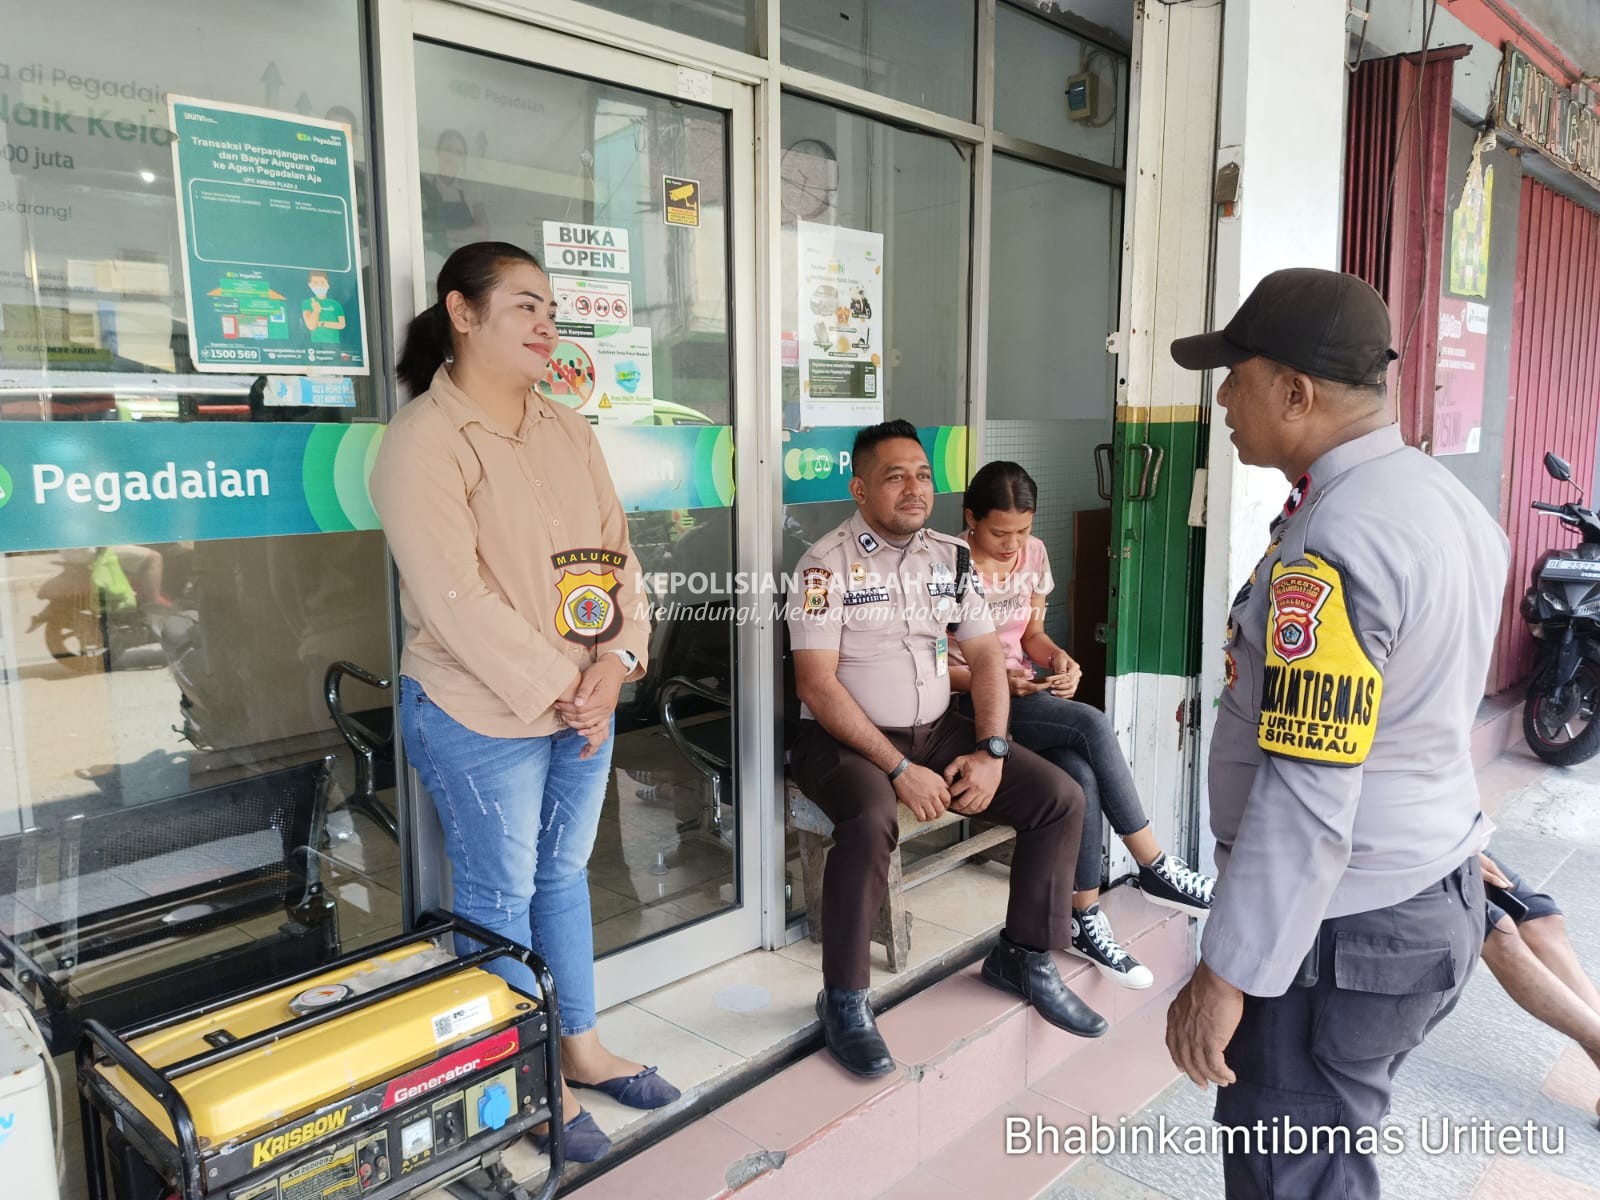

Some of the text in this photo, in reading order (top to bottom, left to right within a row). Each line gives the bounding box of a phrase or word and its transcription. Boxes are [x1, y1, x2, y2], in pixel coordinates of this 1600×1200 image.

[33, 147, 74, 169] juta
[191, 136, 337, 166] Transaksi Perpanjangan Gadai
[219, 152, 316, 173] dan Bayar Angsuran
[213, 160, 322, 184] ke Agen Pegadaian Aja
[559, 226, 616, 247] BUKA
[562, 250, 616, 269] OPEN
[211, 349, 236, 359] 1500
[237, 350, 258, 360] 569
[33, 461, 270, 512] Pegadaian
[1279, 599, 1312, 609] MALUKU
[1267, 715, 1348, 740] URITETU
[1265, 728, 1357, 754] SIRIMAU
[393, 1058, 481, 1104] Generator
[252, 1106, 348, 1169] KRISBOW
